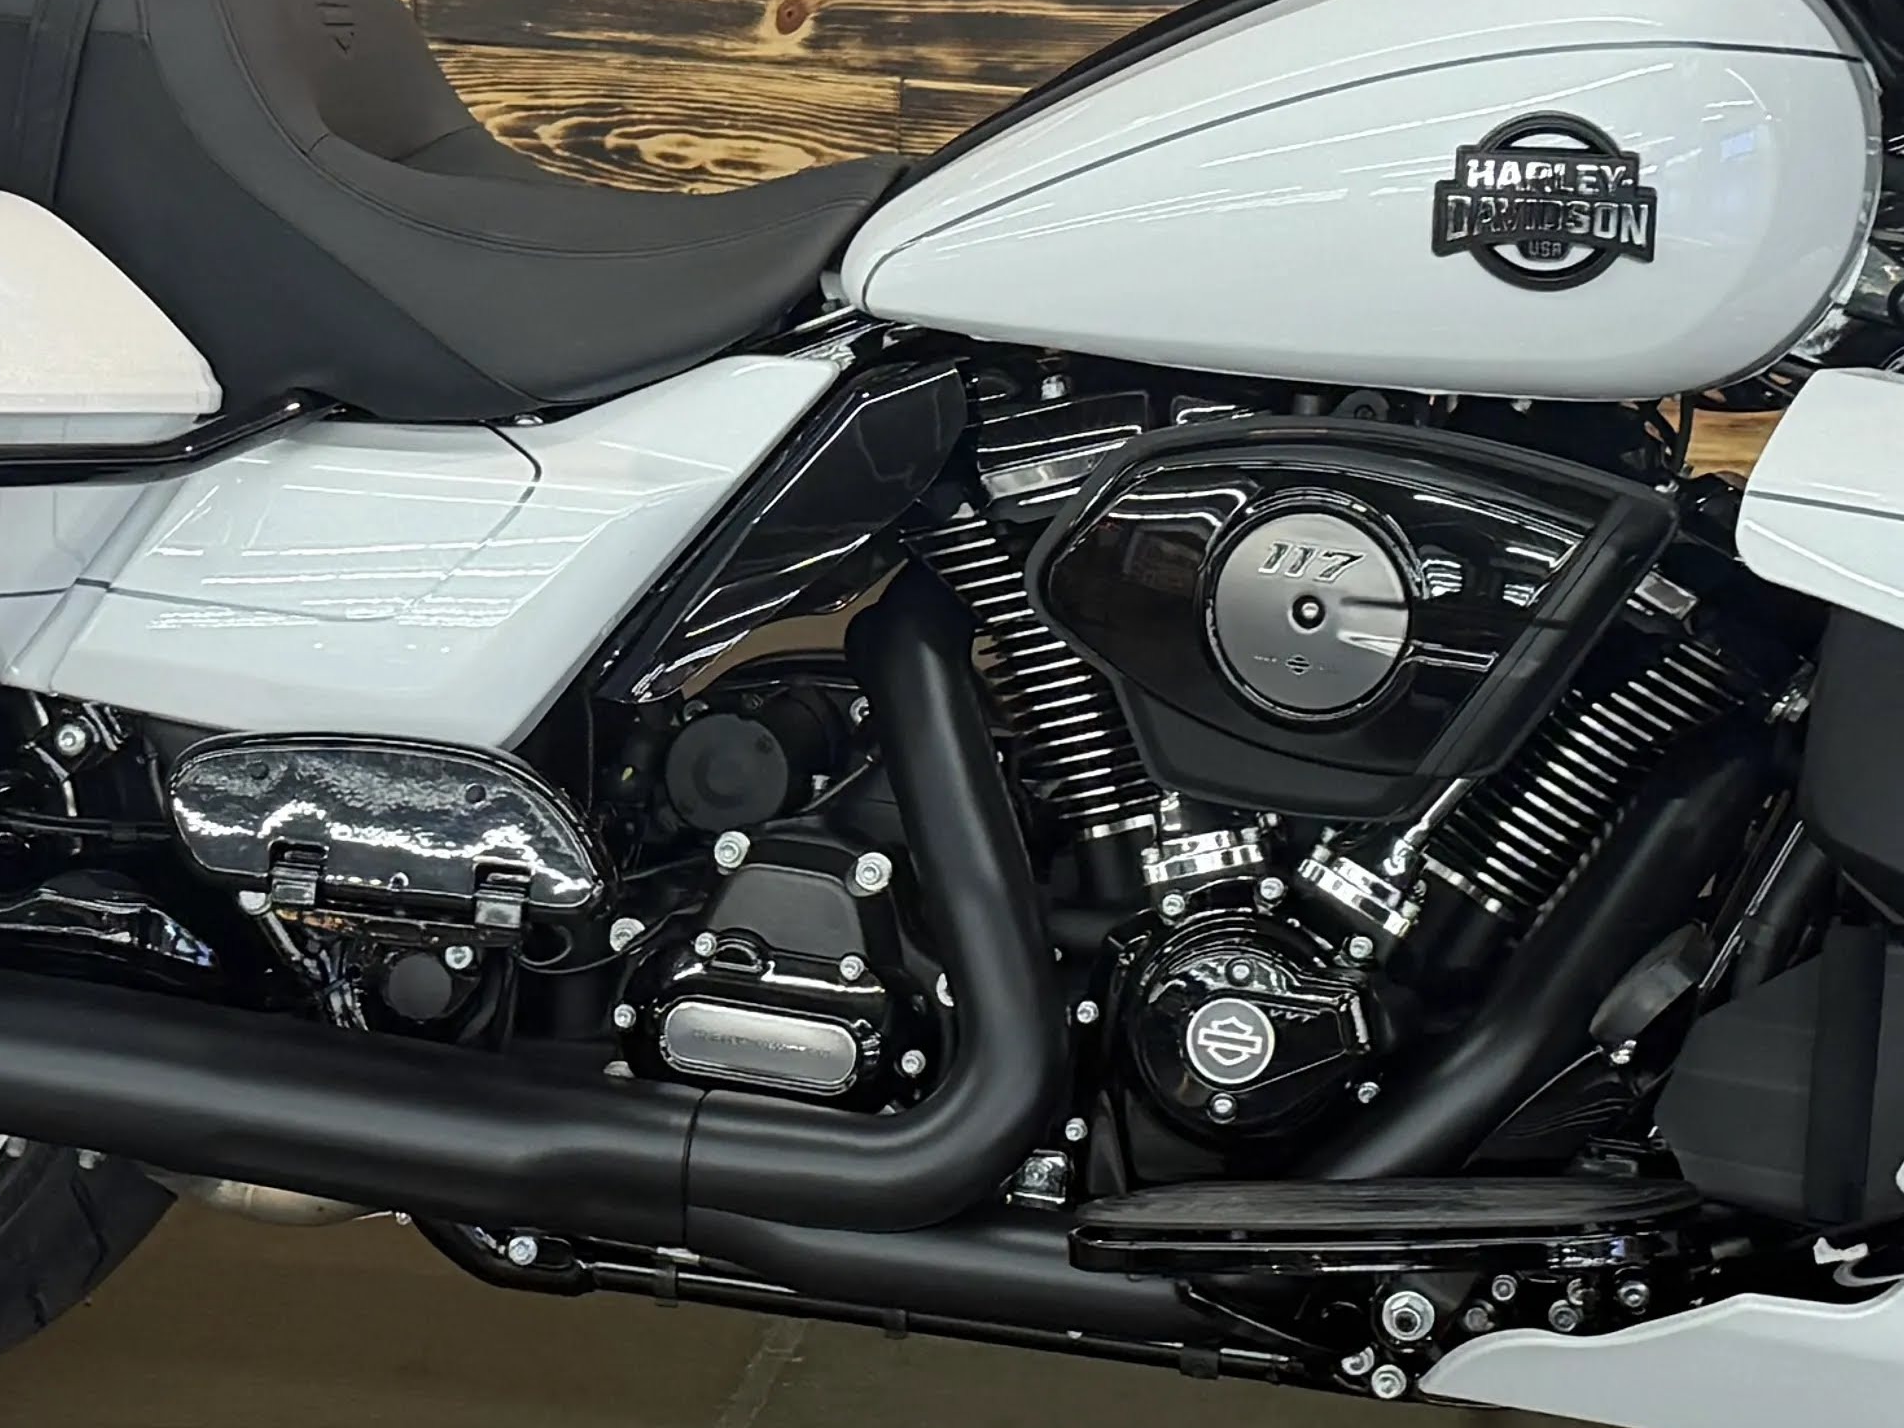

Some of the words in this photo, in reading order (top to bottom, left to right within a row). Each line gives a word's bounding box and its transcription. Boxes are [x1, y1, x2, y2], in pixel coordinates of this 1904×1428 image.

[1465, 158, 1634, 196] HARLEY-
[1445, 194, 1649, 247] DAVIDSON
[1527, 240, 1563, 258] USA
[1258, 540, 1365, 583] 117
